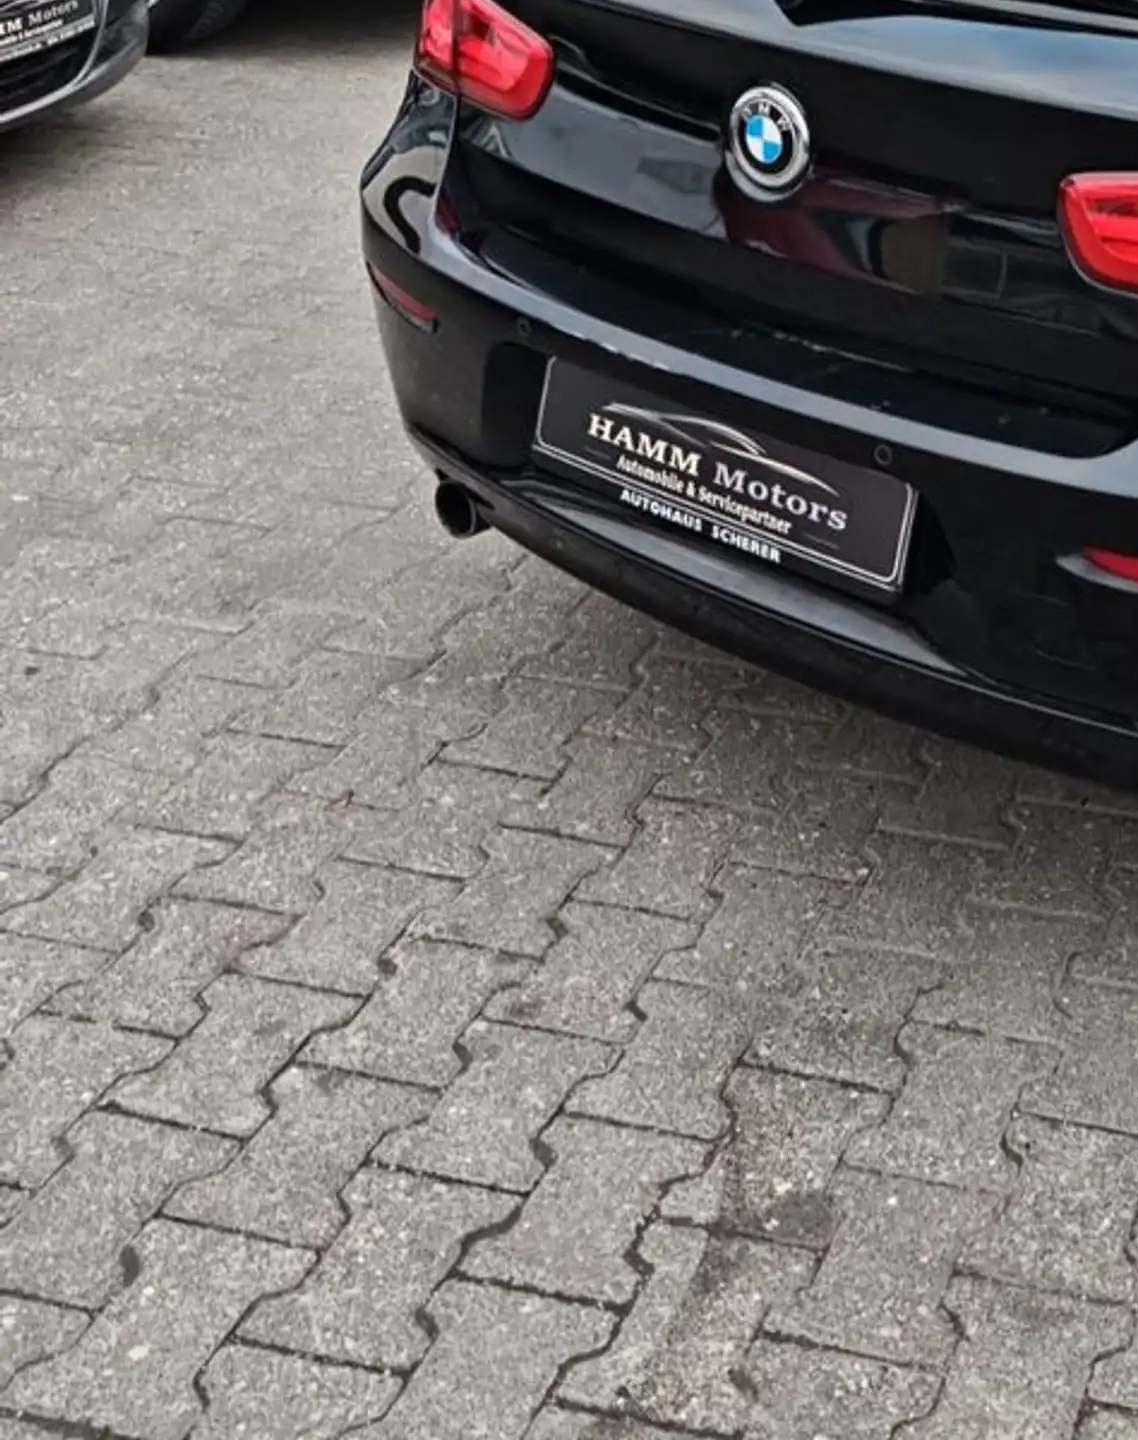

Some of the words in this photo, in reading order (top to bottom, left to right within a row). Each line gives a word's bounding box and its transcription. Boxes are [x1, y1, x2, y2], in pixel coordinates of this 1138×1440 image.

[588, 413, 701, 477] HAMM
[712, 461, 848, 531] Motors
[617, 455, 684, 492] Automobile
[685, 479, 696, 498] &
[698, 485, 793, 535] Servicepartner
[620, 489, 702, 532] AUTOHAUS
[710, 524, 782, 564] SCHERER
